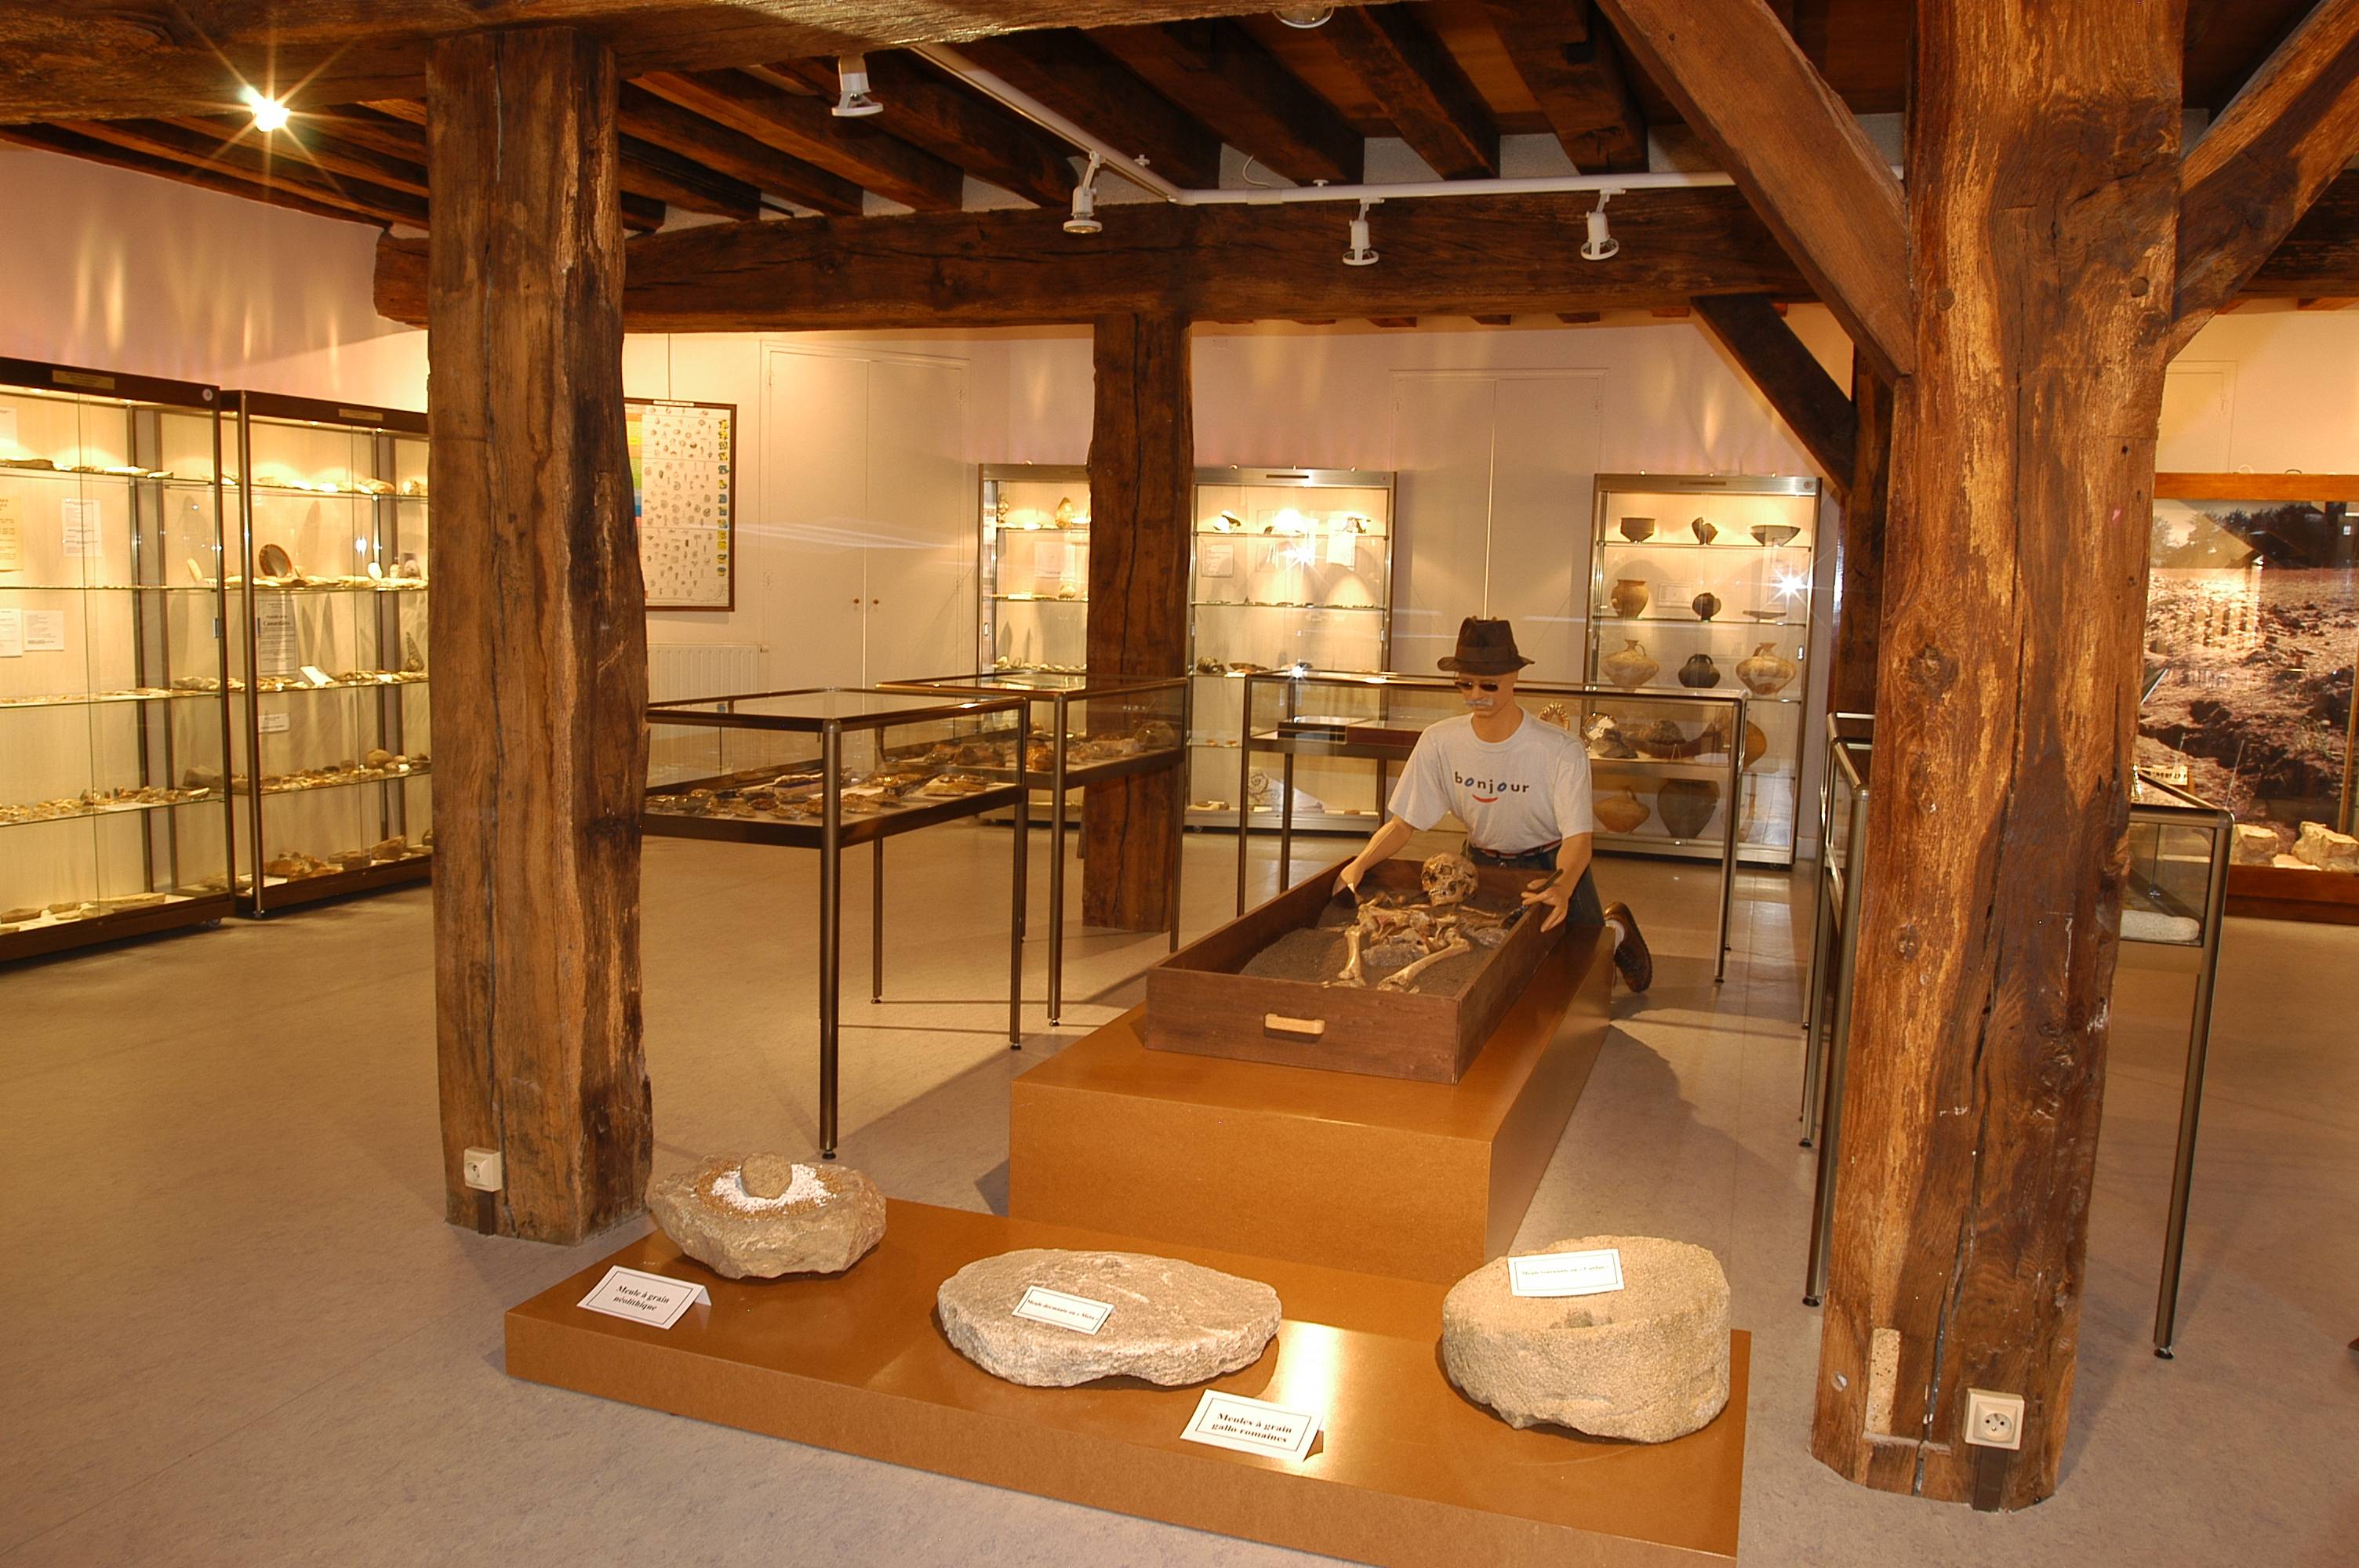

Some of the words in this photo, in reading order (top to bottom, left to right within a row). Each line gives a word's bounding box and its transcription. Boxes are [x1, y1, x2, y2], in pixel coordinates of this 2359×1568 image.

[1455, 771, 1529, 793] bonjour
[613, 1296, 657, 1310] néolithique
[616, 1286, 641, 1297] Meule
[646, 1294, 670, 1304] grain
[1217, 1413, 1252, 1425] Meules
[1263, 1424, 1292, 1434] grain
[1212, 1424, 1237, 1433] gallo
[1240, 1429, 1287, 1443] romaines
